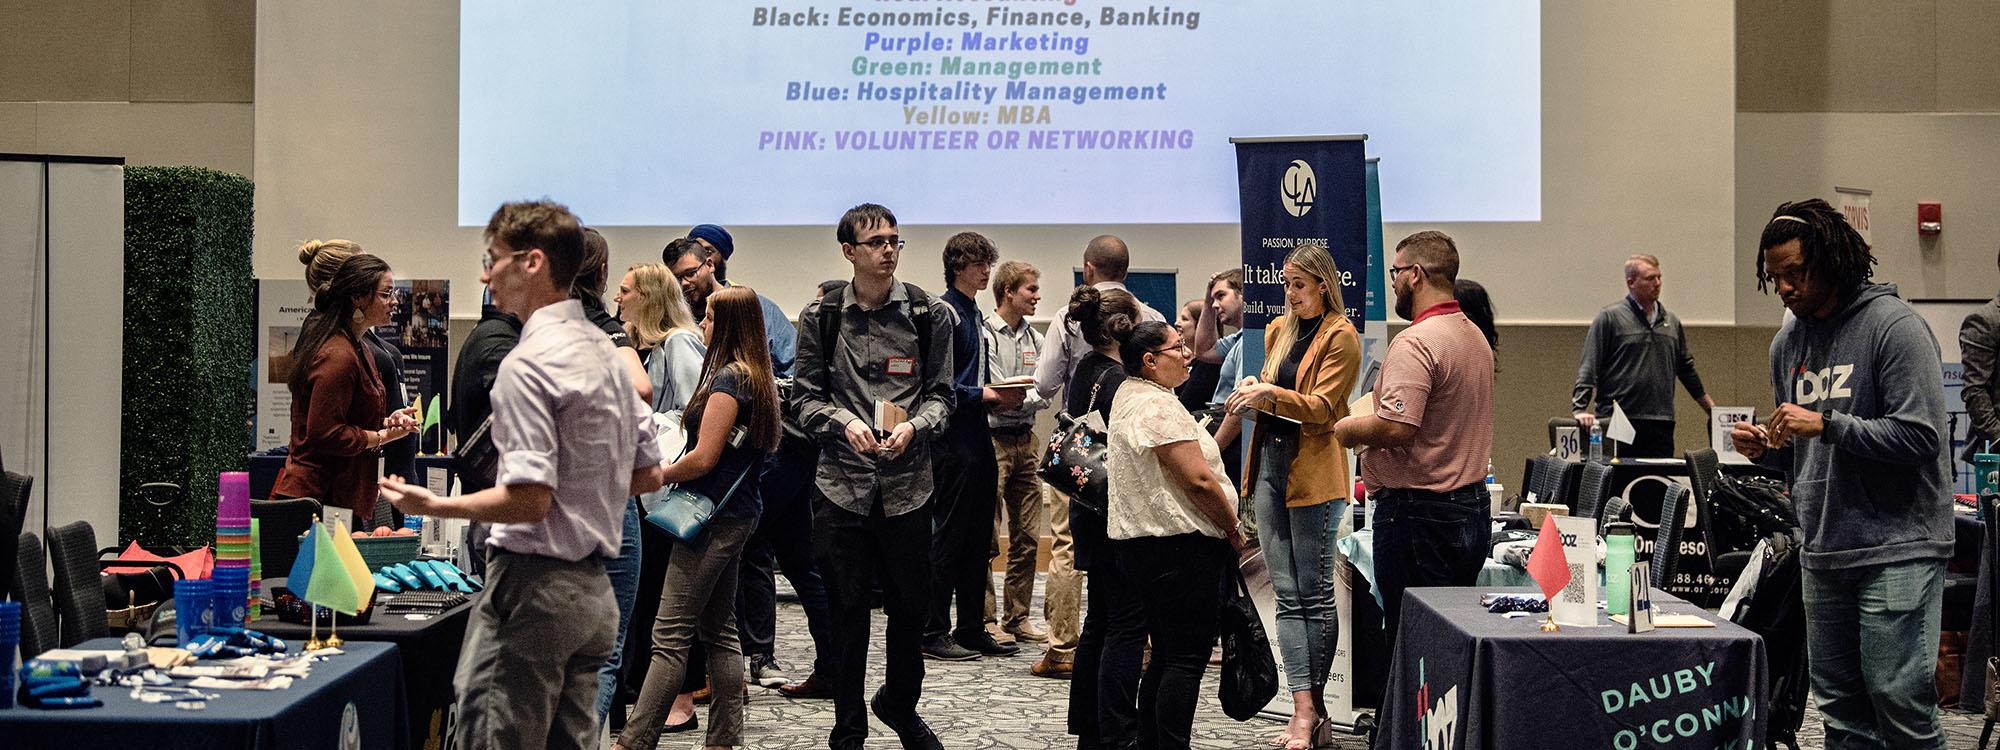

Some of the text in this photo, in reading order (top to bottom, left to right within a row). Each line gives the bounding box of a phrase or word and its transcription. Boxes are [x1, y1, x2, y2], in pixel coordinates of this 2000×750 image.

[752, 7, 1200, 30] Black: Economics, Finance, Banking
[865, 32, 1089, 55] Purple: Marketing
[852, 56, 1102, 79] Green: Management
[786, 81, 1167, 105] Blue: Hospitality Management
[903, 105, 1052, 125] Yellow: MBA
[759, 129, 1193, 150] PINK: VOLUNTEER OR NETWORKING
[1262, 237, 1295, 249] PASSION.
[1244, 263, 1285, 284] It take
[1560, 431, 1578, 459] 36
[1635, 535, 1657, 553] On
[1601, 661, 1715, 714] DAUBY
